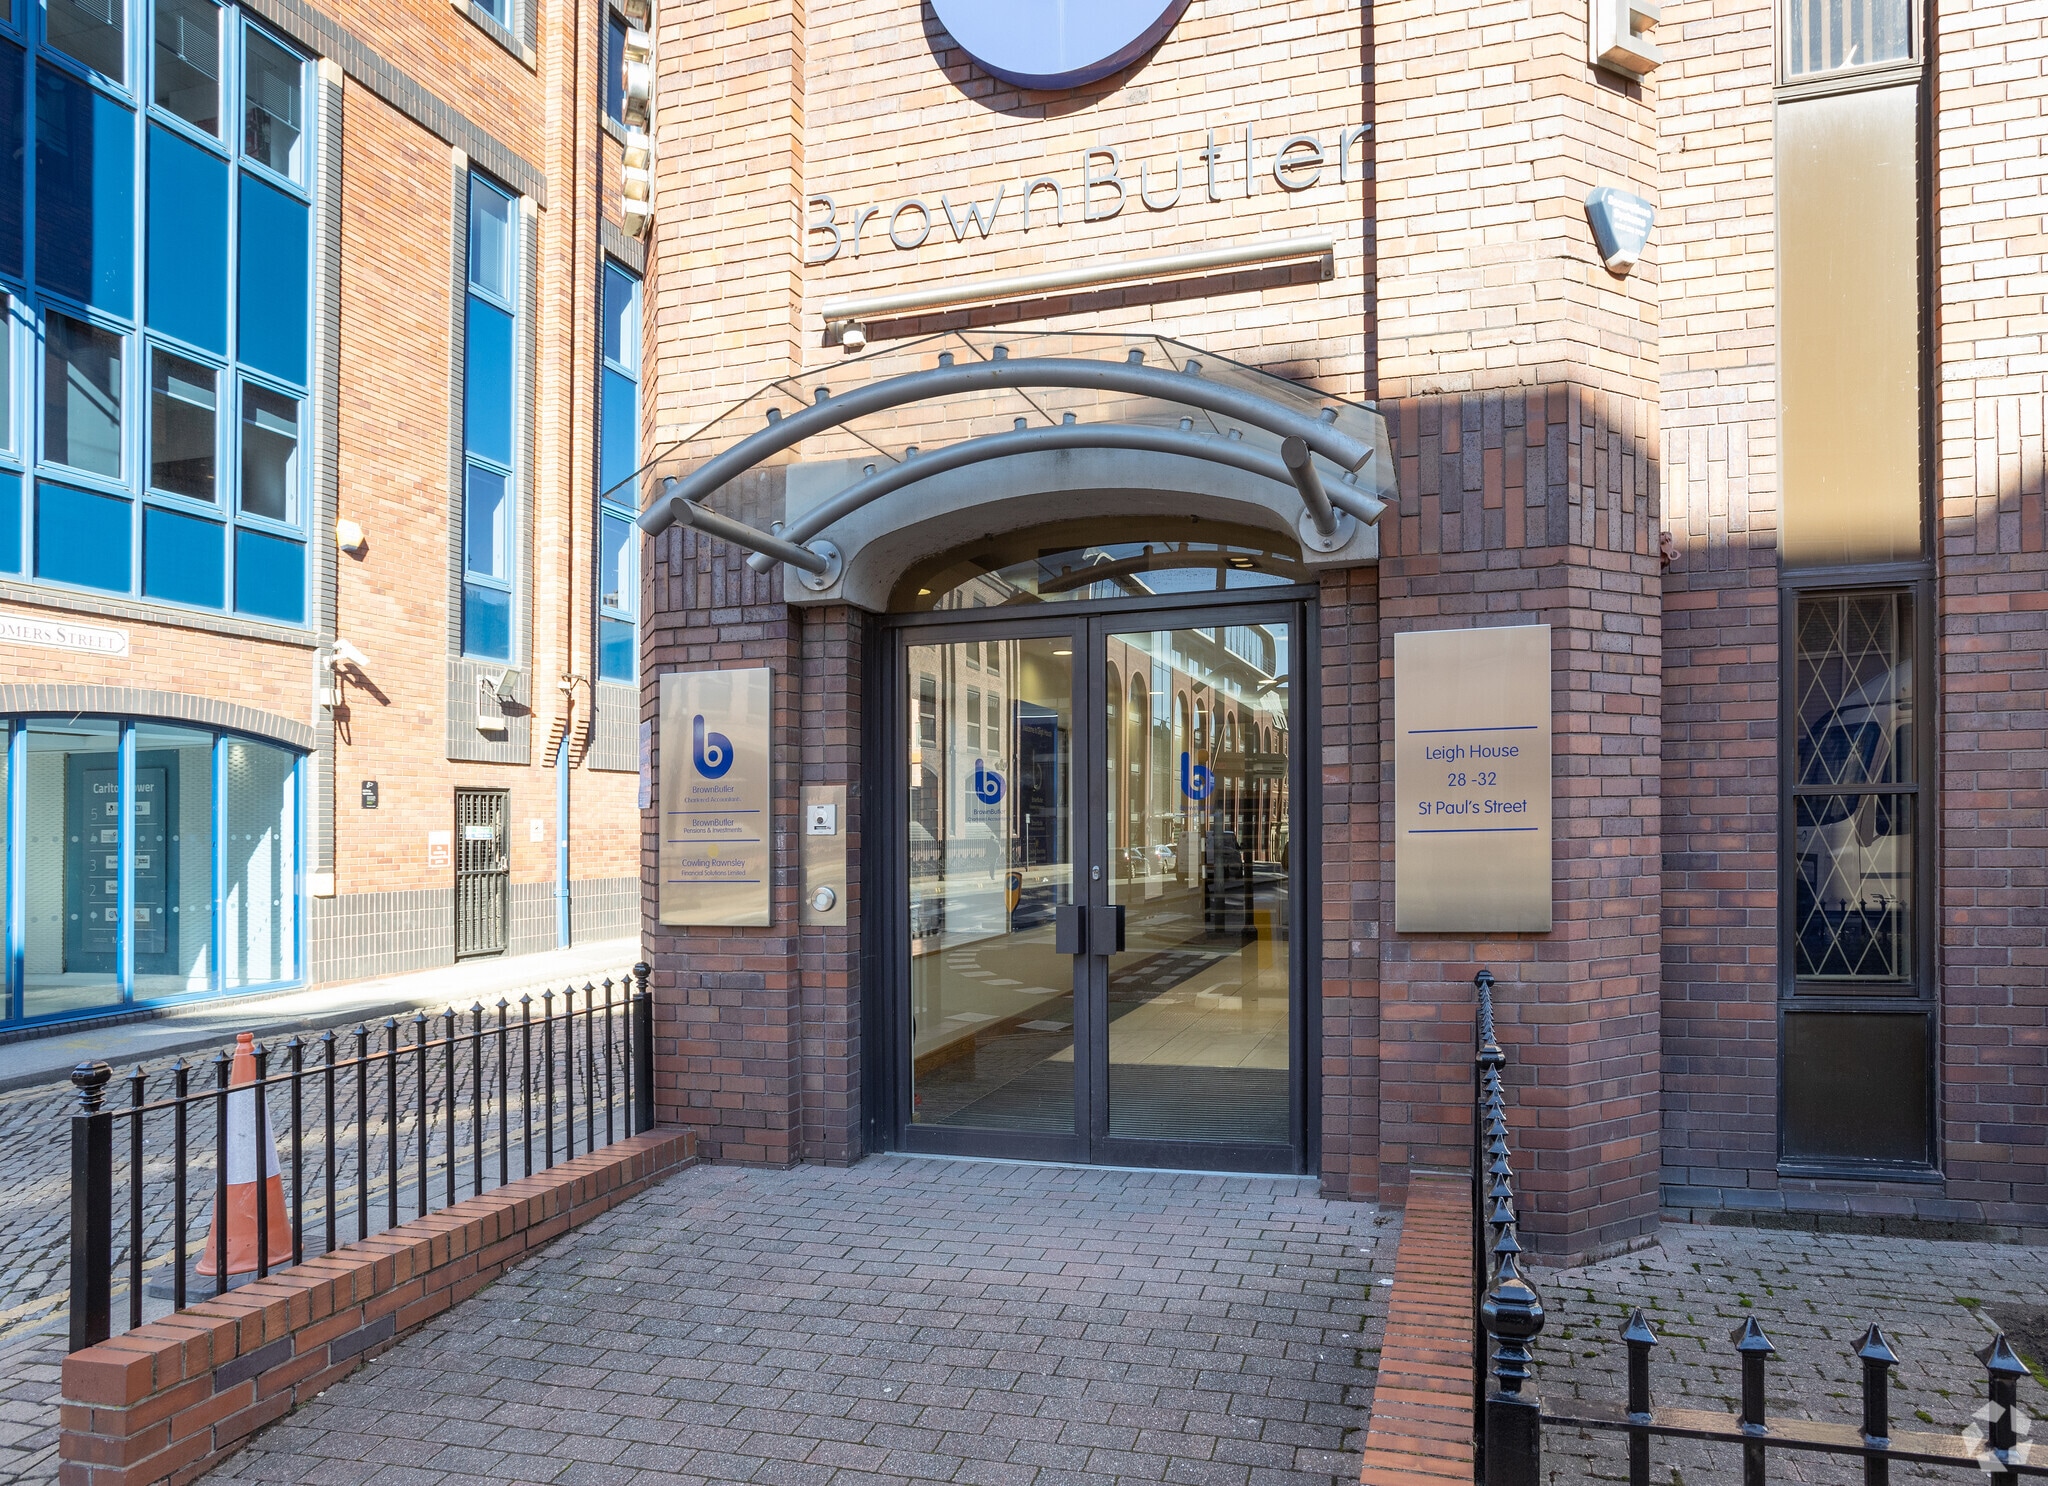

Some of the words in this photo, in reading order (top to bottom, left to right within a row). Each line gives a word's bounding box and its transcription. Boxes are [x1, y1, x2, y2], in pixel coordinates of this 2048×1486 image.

[804, 121, 1372, 265] BrownButler
[56, 627, 115, 649] STREET
[1426, 744, 1465, 763] Leigh
[1469, 744, 1519, 758] House
[1447, 772, 1467, 787] 28
[1471, 771, 1497, 786] -32
[93, 783, 119, 794] Carlto
[692, 785, 734, 794] BrownButler
[1418, 801, 1432, 815] St
[1436, 800, 1480, 815] Paul's
[1484, 799, 1527, 814] Street
[692, 818, 734, 827] BrownButler
[89, 859, 97, 872] 3
[682, 859, 711, 869] Cowling
[711, 858, 746, 868] Rawnsley
[89, 884, 96, 897] 2
